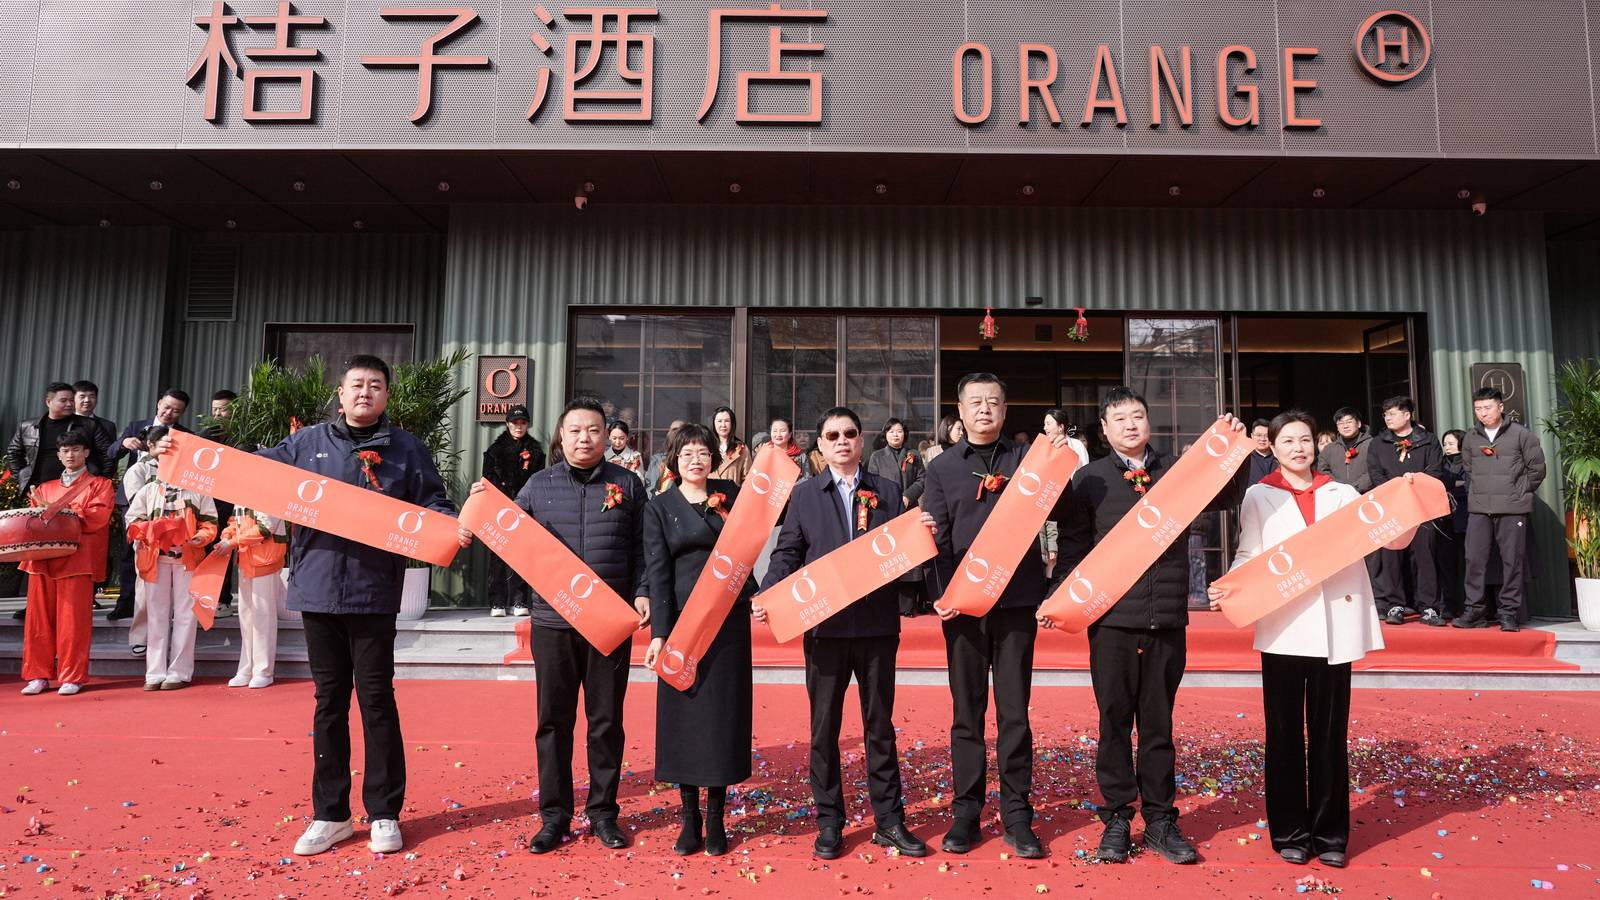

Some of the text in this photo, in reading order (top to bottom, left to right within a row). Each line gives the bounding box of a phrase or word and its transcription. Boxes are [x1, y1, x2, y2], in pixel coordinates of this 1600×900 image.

[184, 1, 828, 123] 桔子酒店
[952, 42, 1323, 128] ORANGE
[182, 470, 217, 487] ORANGE
[1035, 480, 1057, 508] ORANGE
[287, 502, 320, 518] ORANGE
[388, 532, 418, 548] ORANGE
[482, 522, 508, 546] ORANGE
[1152, 518, 1177, 543] ORANGE
[1367, 519, 1401, 541] ORANGE
[880, 552, 909, 573] ORANGE
[728, 560, 745, 592] ORANGE
[1276, 570, 1307, 592] ORANGE
[556, 591, 582, 615] ORANGE
[800, 597, 829, 620] ORANGE
